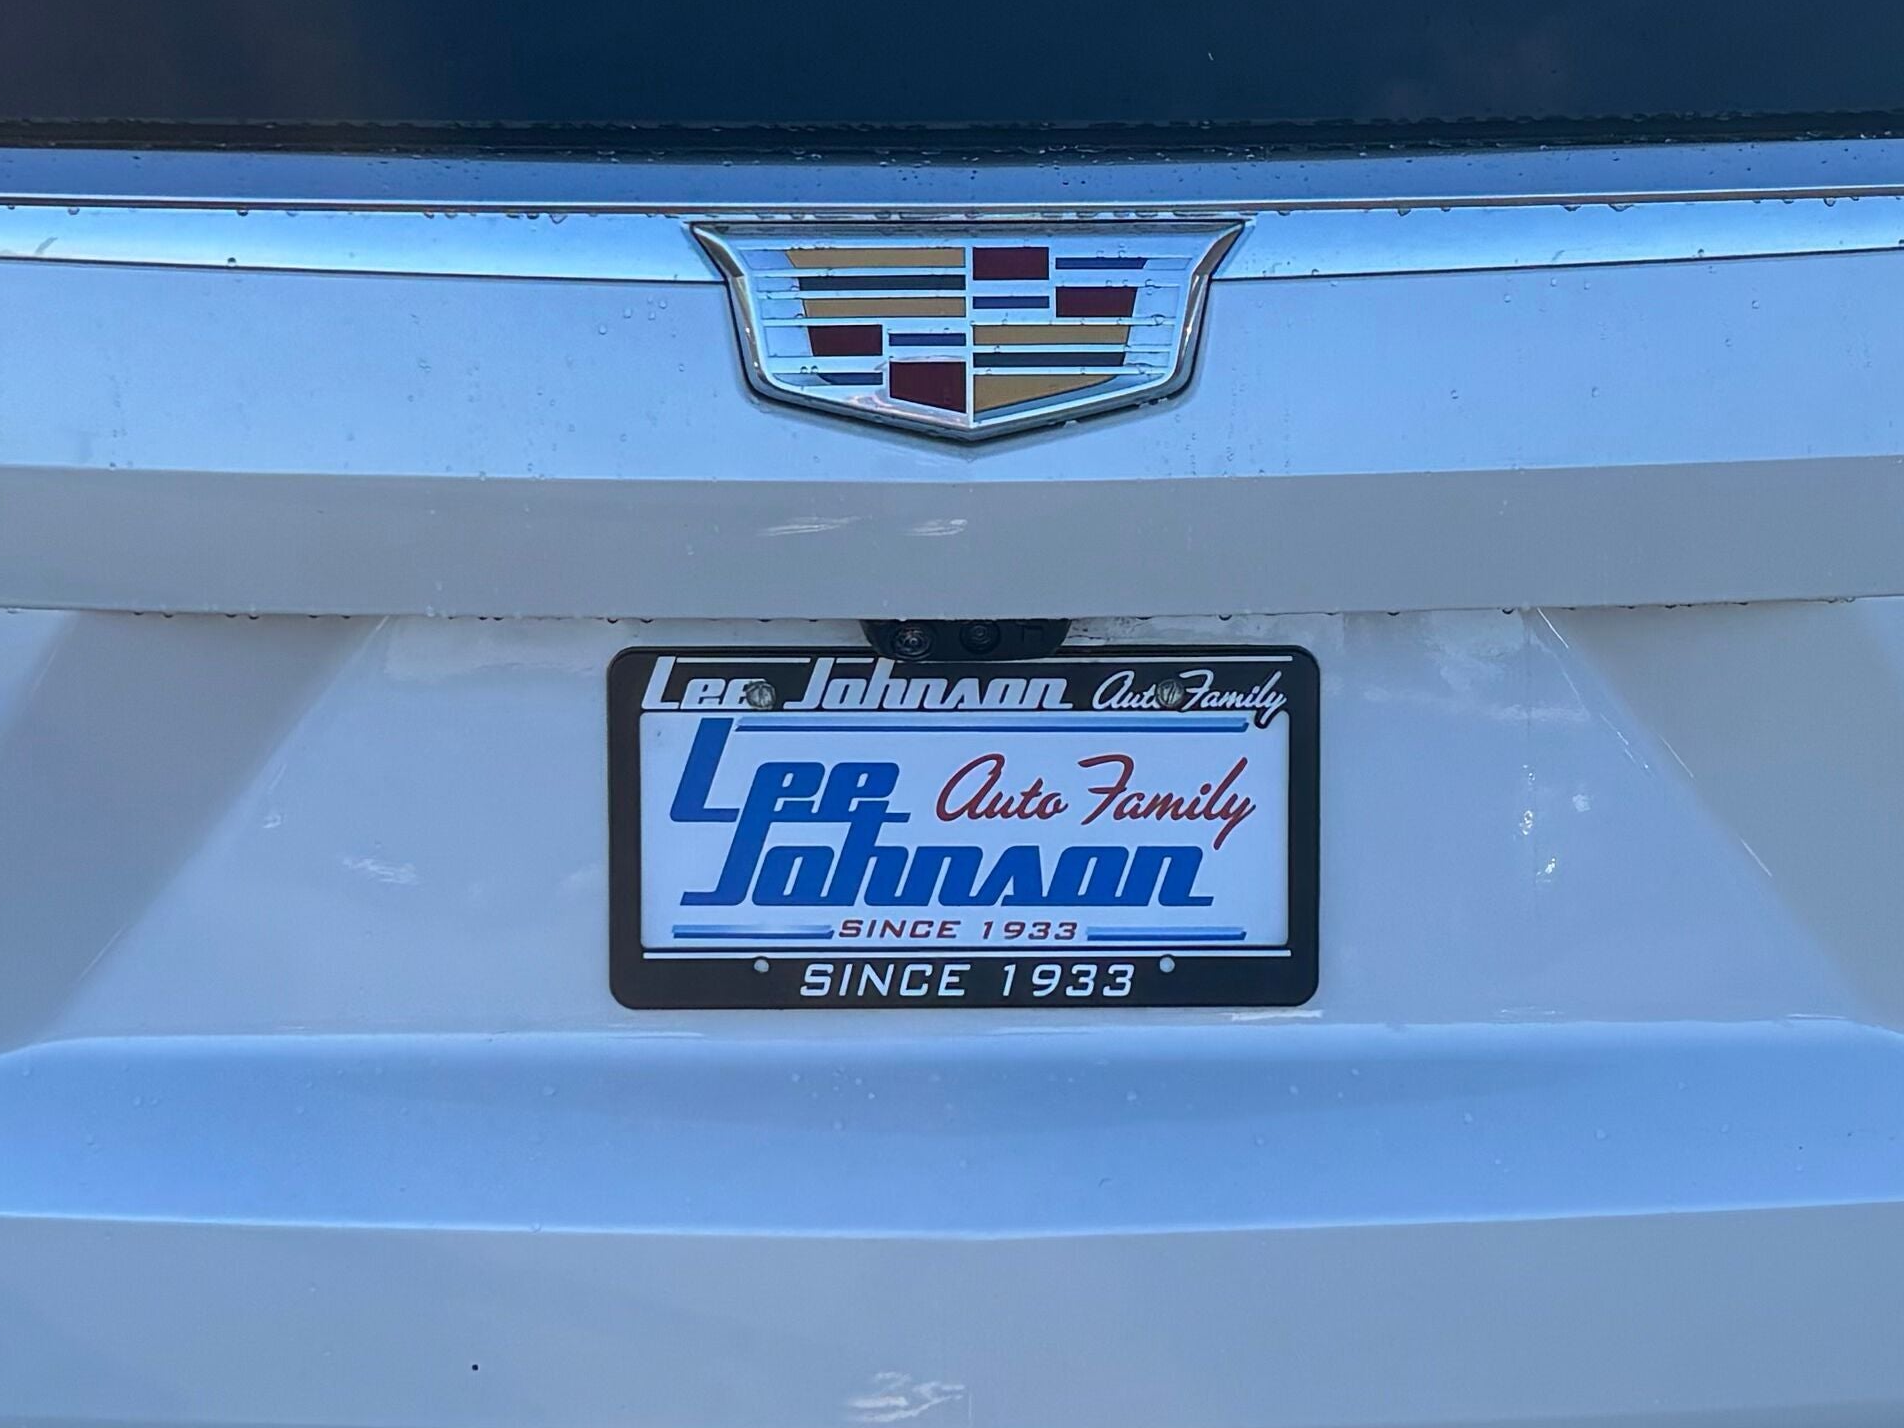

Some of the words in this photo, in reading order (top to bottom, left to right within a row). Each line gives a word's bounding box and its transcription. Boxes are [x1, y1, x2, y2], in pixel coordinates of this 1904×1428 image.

[783, 657, 1073, 710] Johnson
[1092, 670, 1168, 711] Aut
[1179, 669, 1287, 725] Family
[669, 717, 911, 823] Lee
[935, 753, 1068, 825] Auto
[1077, 753, 1257, 850] Family
[679, 821, 1215, 907] Johnson
[839, 919, 961, 939] SINCE
[982, 920, 1078, 940] 1933
[799, 963, 971, 997] SINCE
[1002, 963, 1135, 997] 1933
